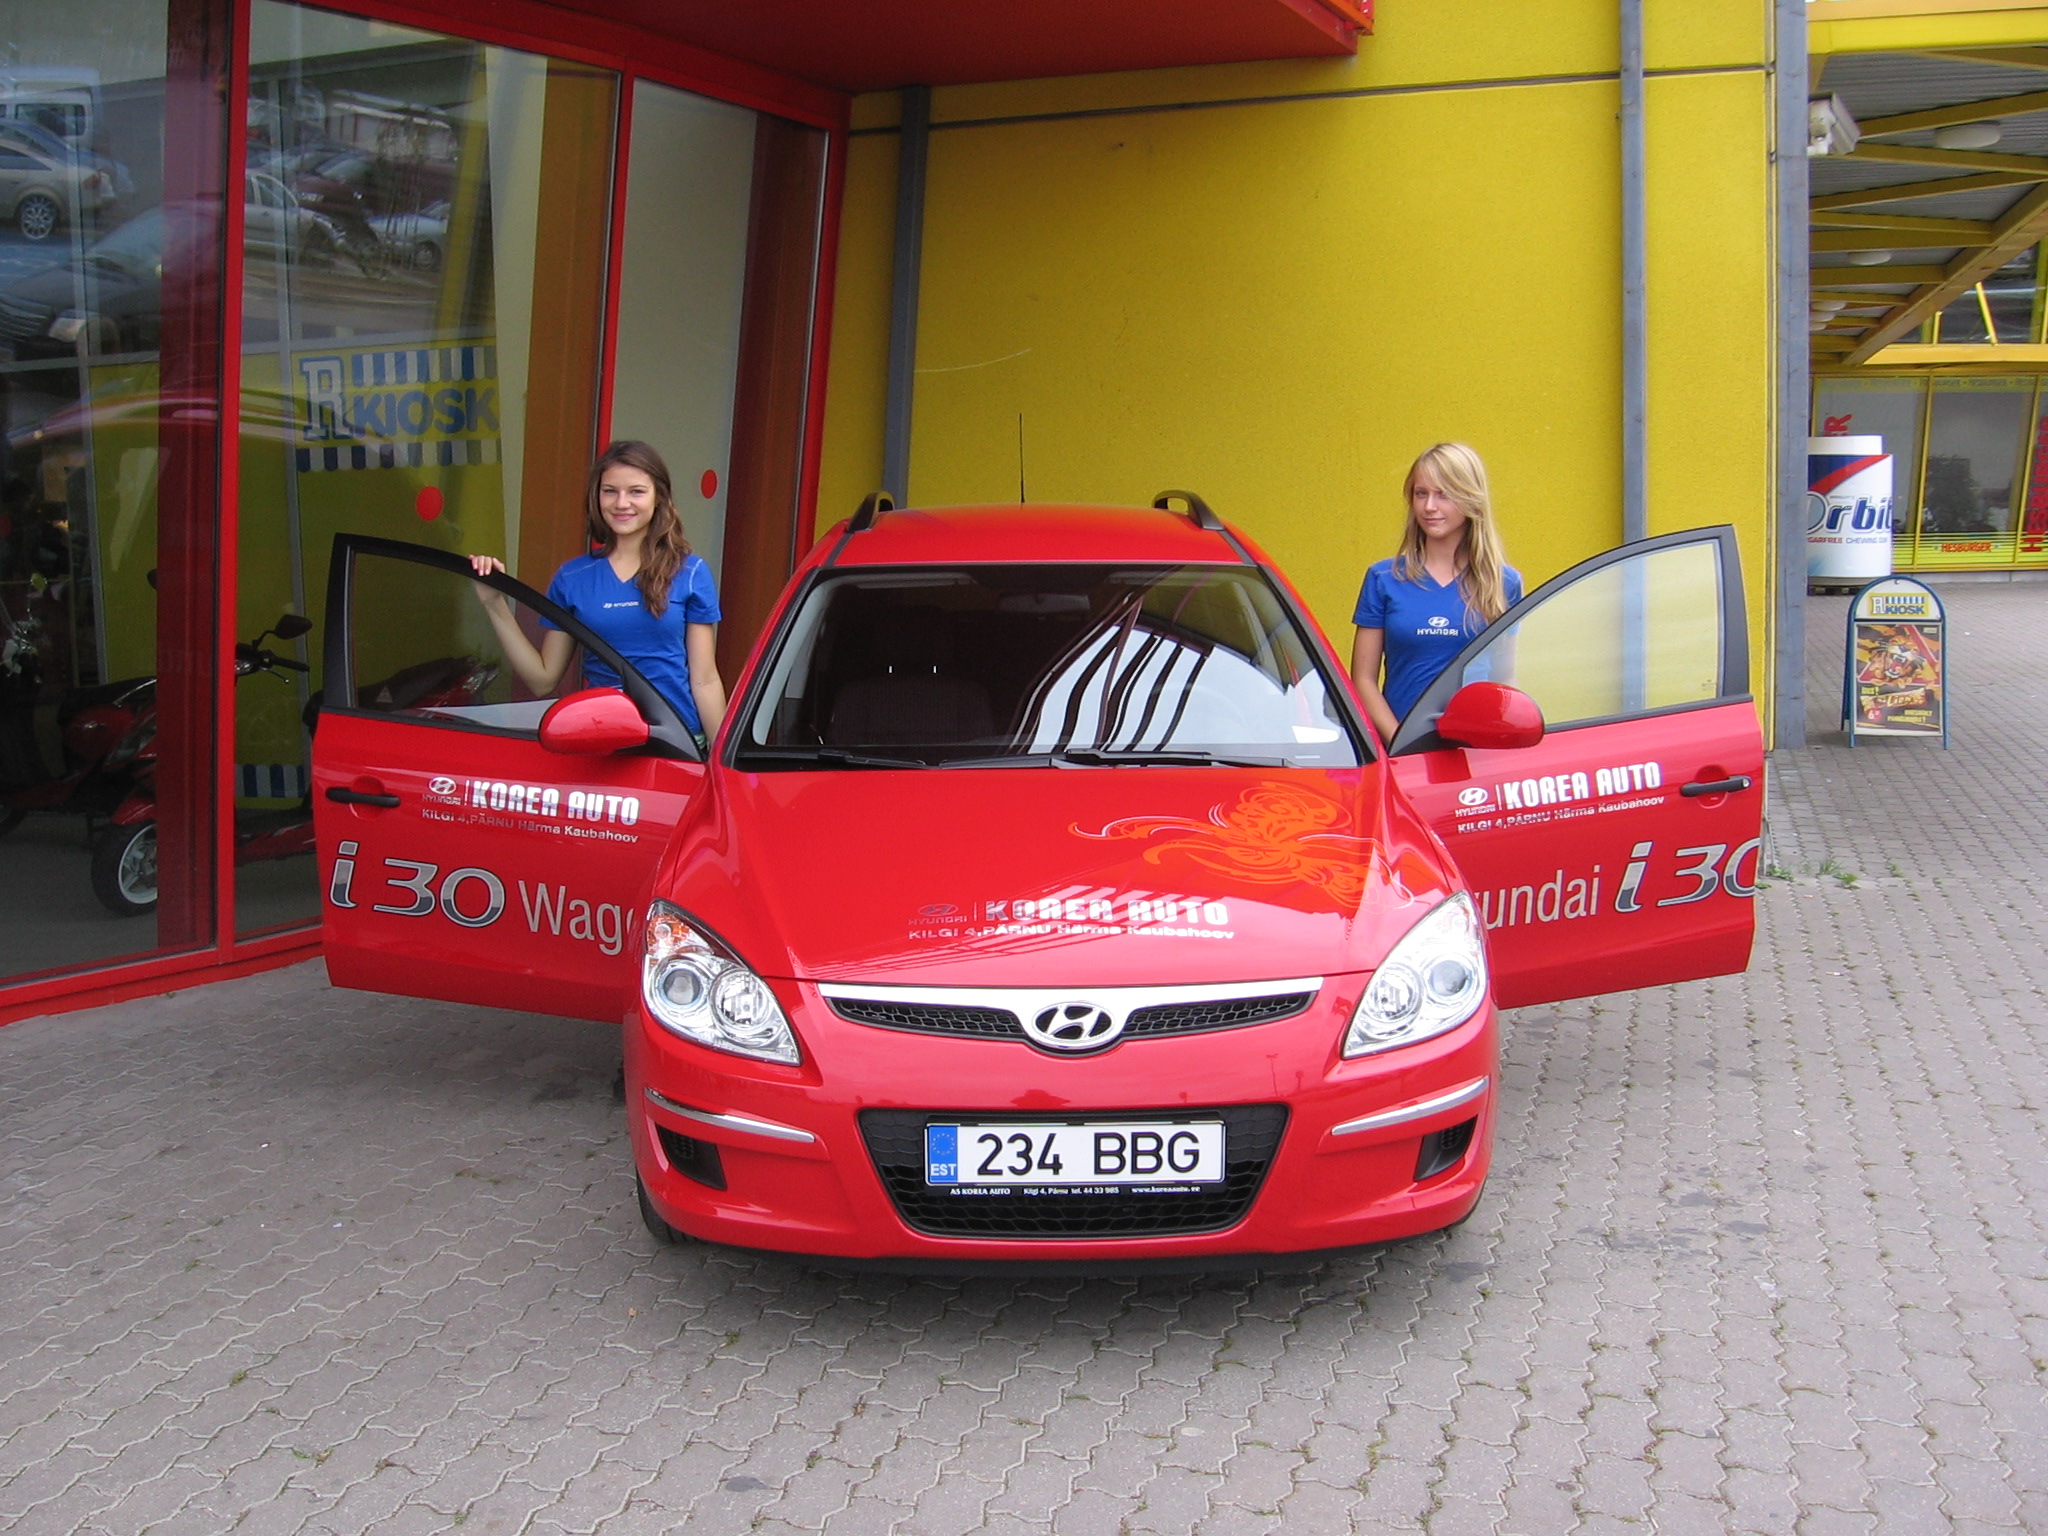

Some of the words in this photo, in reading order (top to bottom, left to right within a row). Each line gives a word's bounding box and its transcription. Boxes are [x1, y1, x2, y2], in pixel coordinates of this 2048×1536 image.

[353, 387, 500, 436] KIOSK
[1885, 605, 1925, 614] KIOSK
[1416, 628, 1459, 636] HYUNDAI
[472, 780, 560, 817] KOREA
[567, 791, 640, 826] AUTO
[1455, 804, 1496, 817] HYUNDAI
[1503, 771, 1590, 810] KOREA
[1595, 761, 1661, 797] AUTO
[564, 825, 638, 843] Kaubahoov
[1457, 819, 1492, 833] KILGI
[1598, 796, 1665, 813] Kaubahoov
[373, 857, 506, 928] 30
[517, 879, 635, 956] Wag
[908, 916, 967, 926] HYUNDAI
[985, 898, 1114, 922] KOREA
[1127, 899, 1230, 926] AUTO
[1480, 864, 1601, 930] undai
[908, 927, 959, 940] KILGI
[1057, 923, 1122, 935] Härma
[1127, 926, 1235, 939] Kaubahoov
[930, 1163, 956, 1176] EST
[977, 1133, 1063, 1176] 234
[1094, 1131, 1200, 1176] BBG
